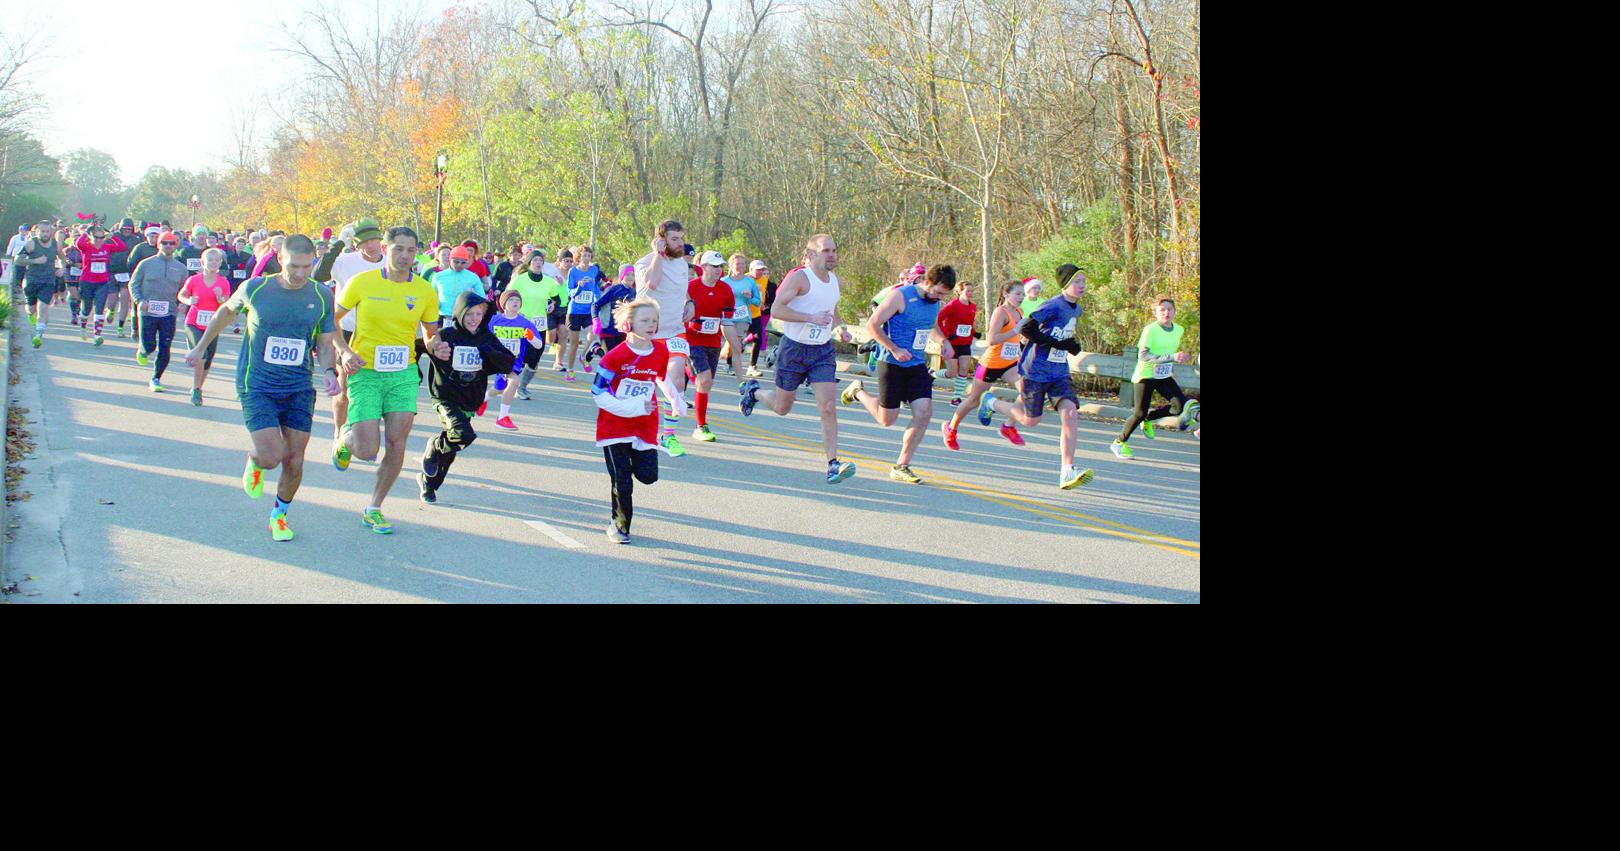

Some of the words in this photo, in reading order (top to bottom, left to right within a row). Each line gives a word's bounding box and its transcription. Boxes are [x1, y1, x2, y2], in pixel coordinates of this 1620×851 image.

[810, 328, 822, 340] 37
[271, 346, 298, 362] 930
[380, 352, 403, 365] 504
